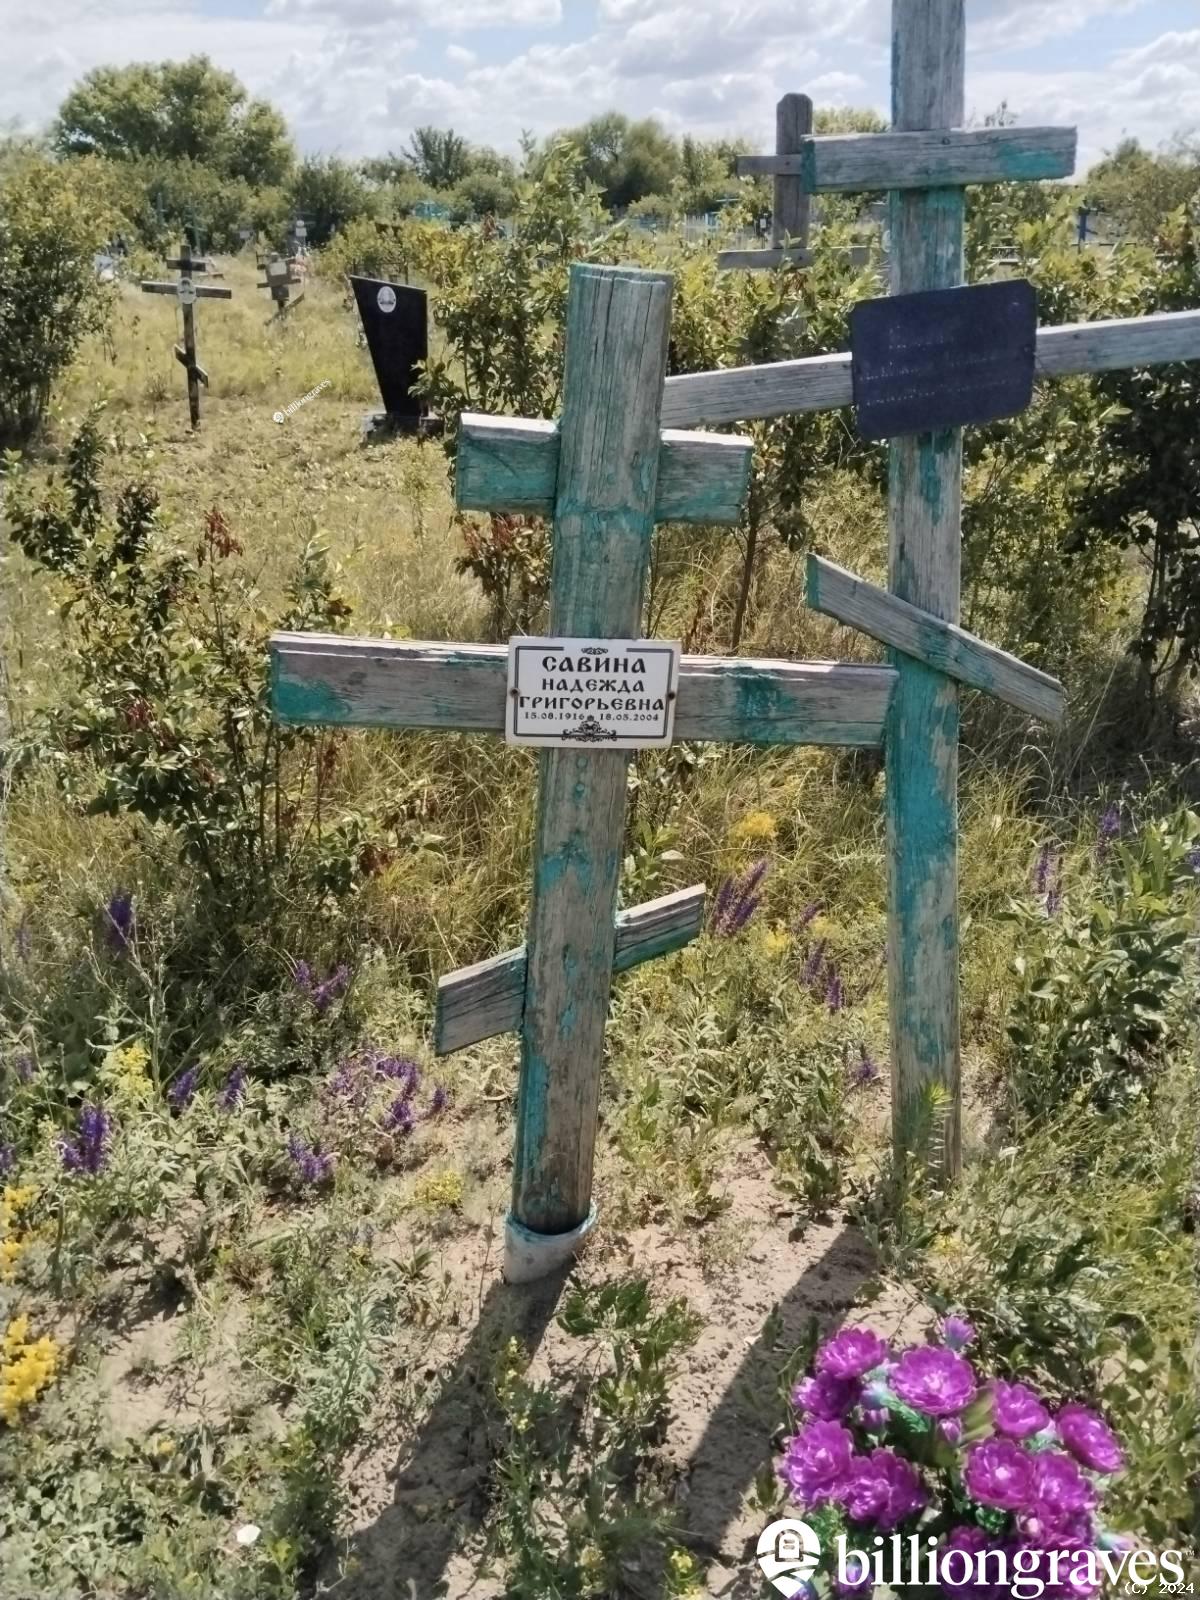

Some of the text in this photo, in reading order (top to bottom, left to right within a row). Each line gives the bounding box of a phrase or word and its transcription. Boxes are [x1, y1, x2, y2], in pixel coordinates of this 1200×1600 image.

[542, 656, 646, 674] САВИНА
[542, 678, 645, 694] НАДЕЖДА
[519, 696, 664, 711] ГРИГОРЬЕВНА
[600, 713, 659, 721] 18.05.2004
